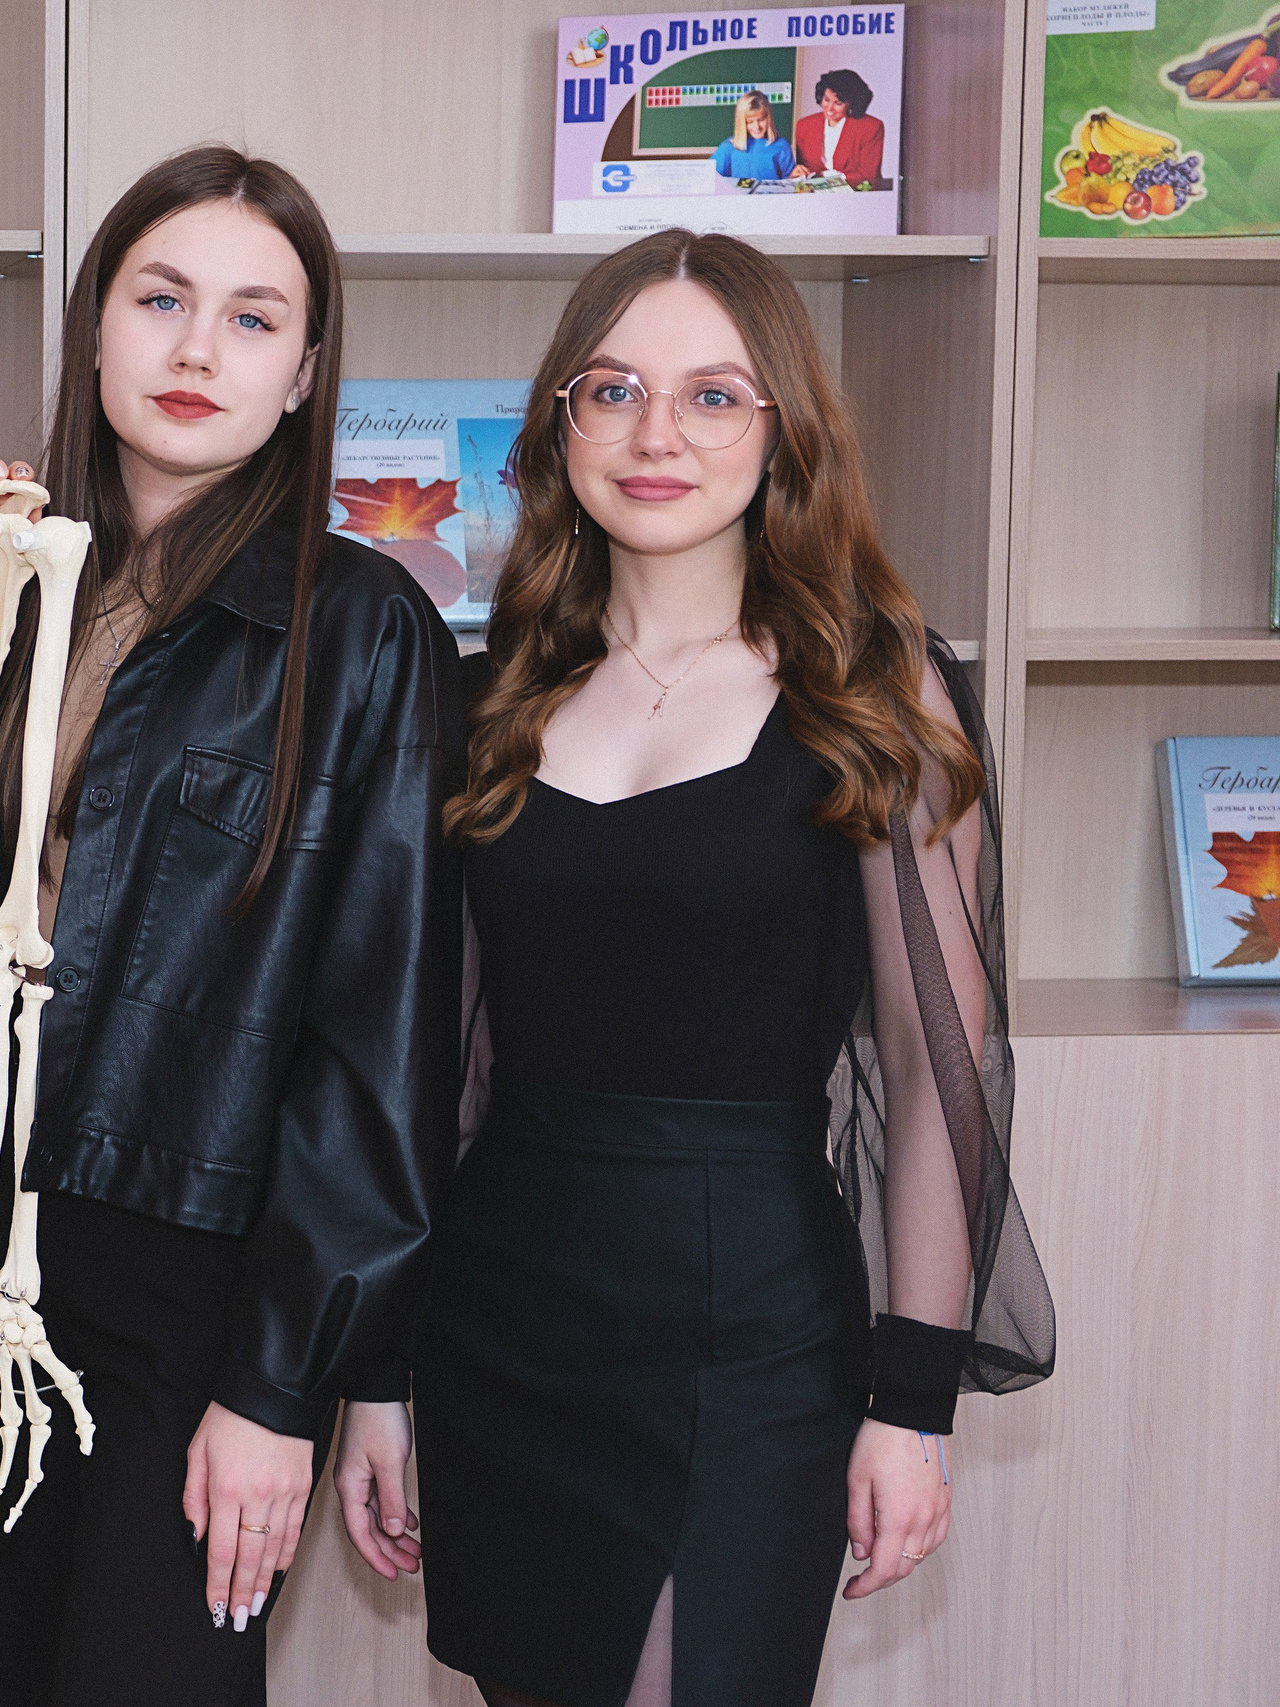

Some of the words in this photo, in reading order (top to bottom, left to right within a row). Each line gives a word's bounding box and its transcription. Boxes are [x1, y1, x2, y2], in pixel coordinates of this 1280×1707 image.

[564, 17, 758, 123] ШКОЛЬНОЕ
[787, 12, 896, 38] ПОСОБИЕ
[335, 407, 453, 441] Гербарий
